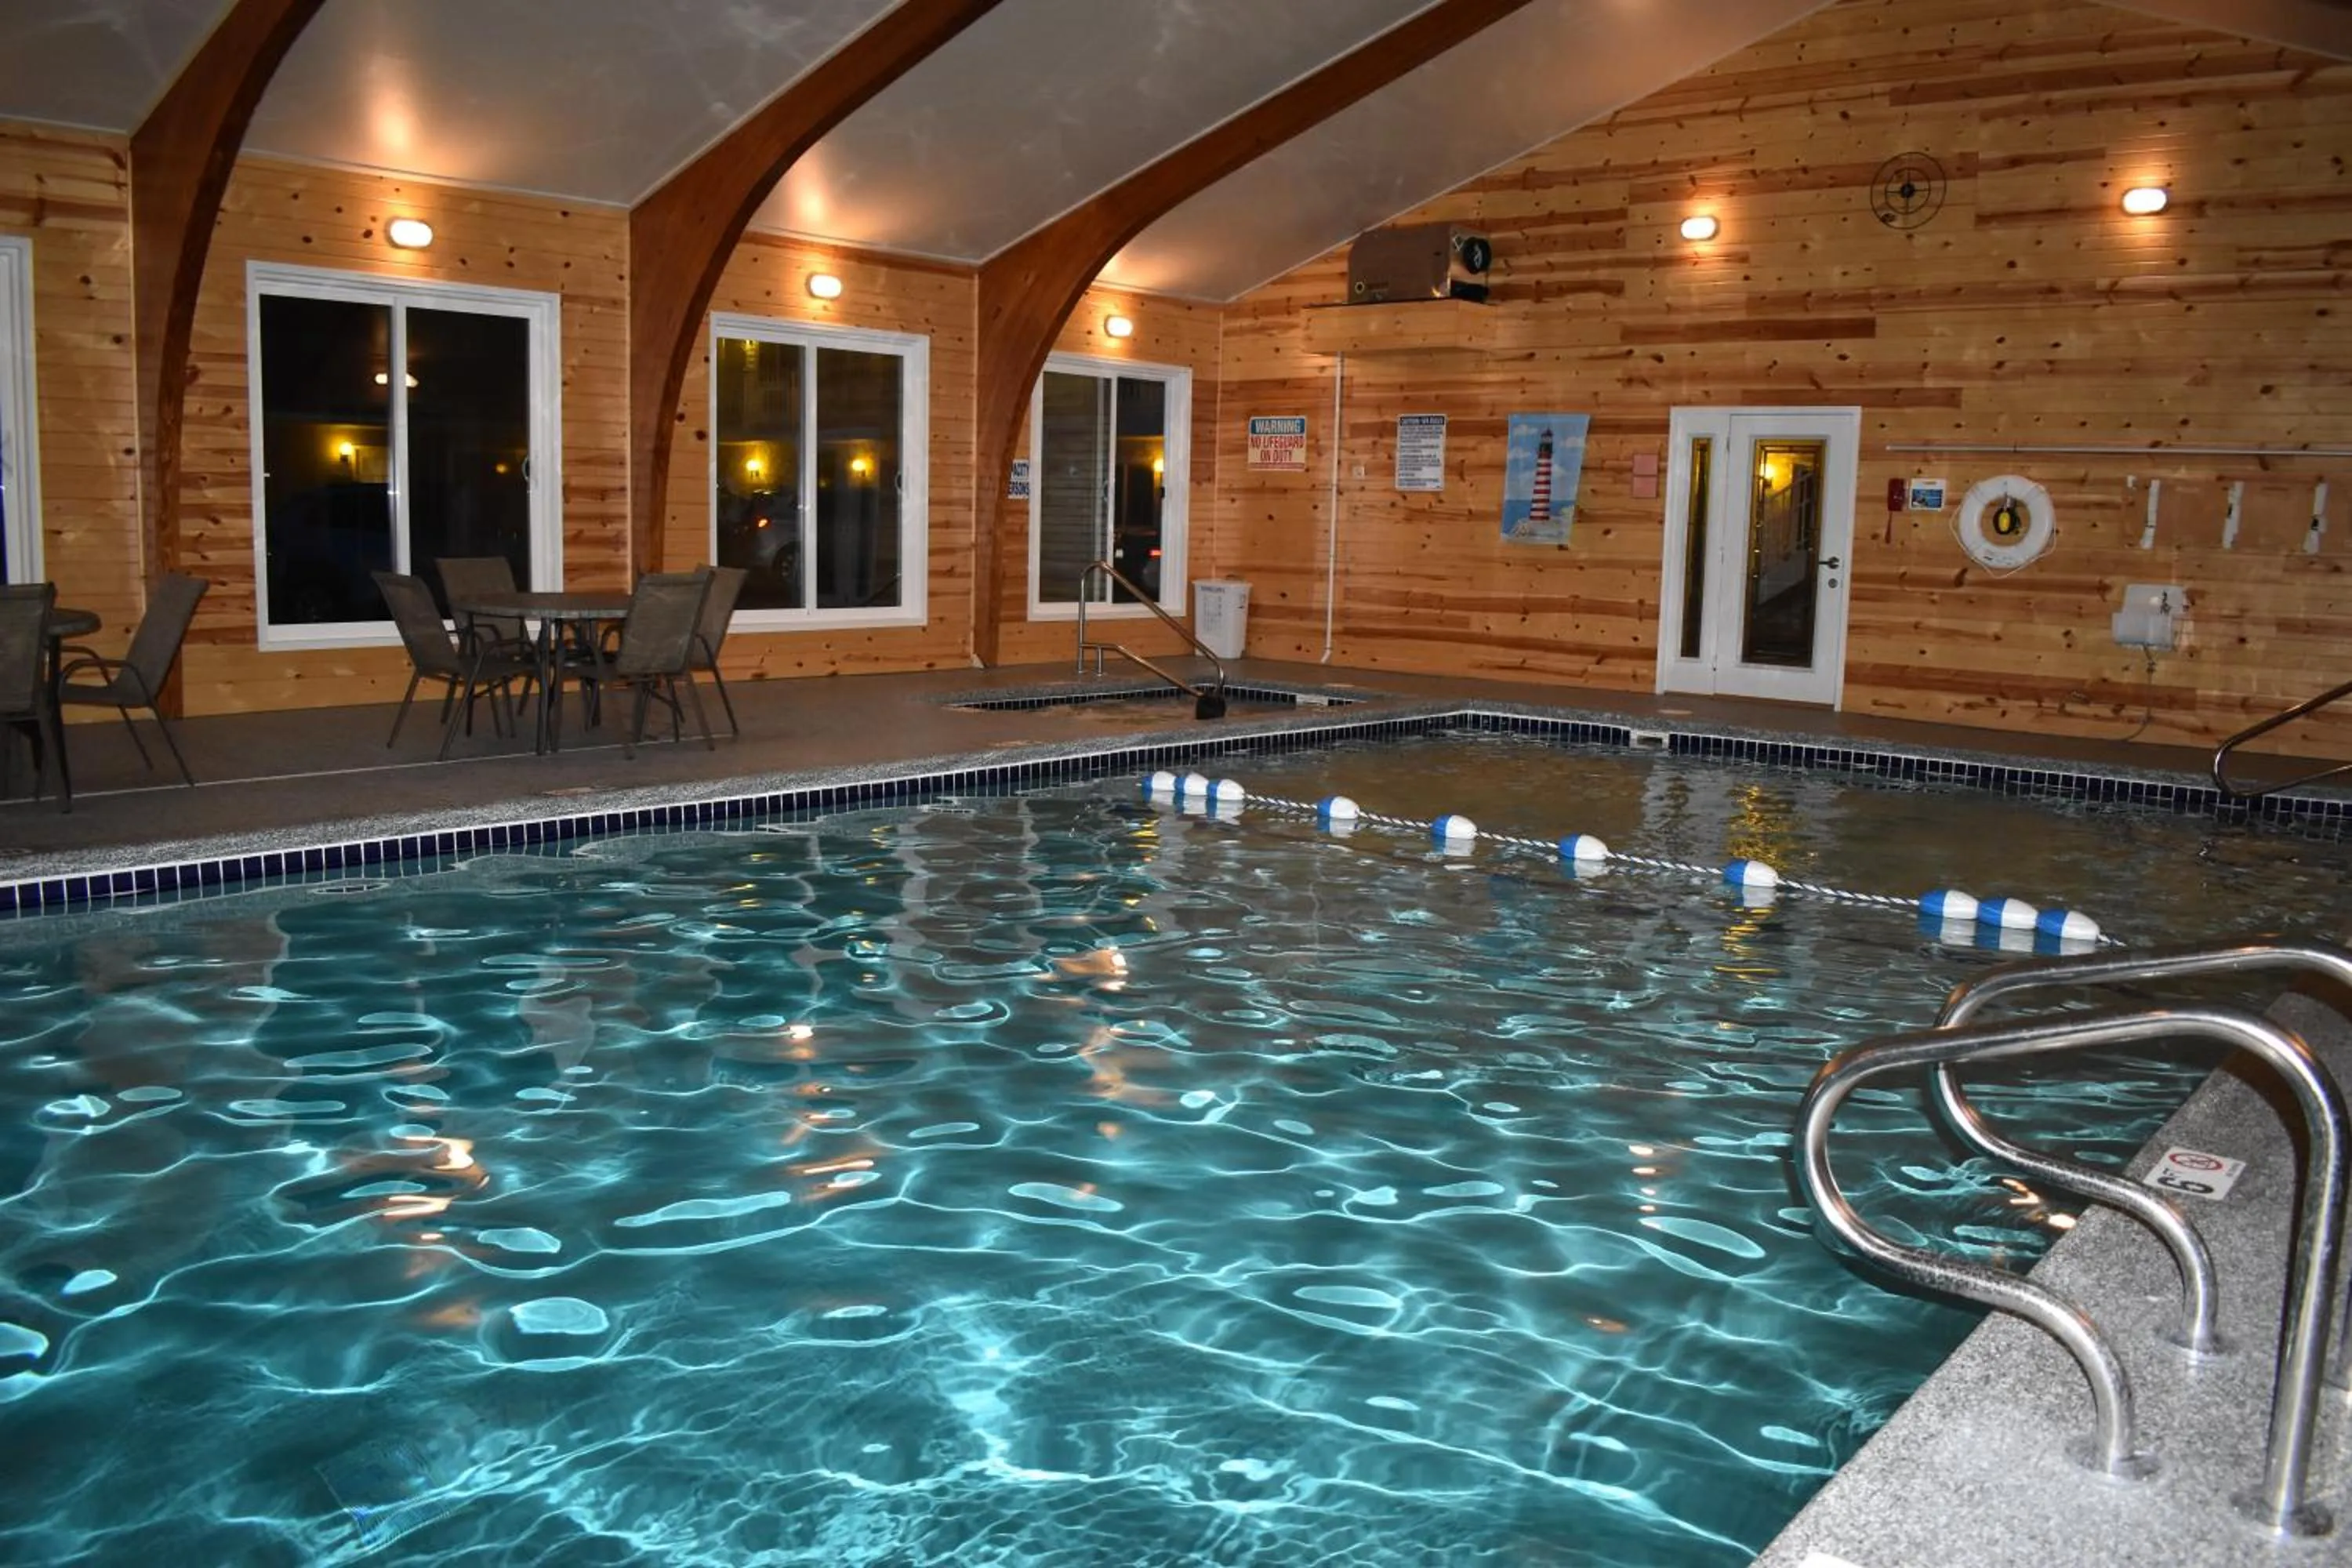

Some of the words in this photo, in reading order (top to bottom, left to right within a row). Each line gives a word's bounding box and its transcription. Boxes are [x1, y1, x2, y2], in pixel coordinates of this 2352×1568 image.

[1255, 419, 1301, 434] WARNING
[1250, 436, 1261, 448] NO
[1263, 436, 1305, 448] LIFEGUARD
[1261, 449, 1271, 461] ON
[1273, 449, 1292, 461] DUTY
